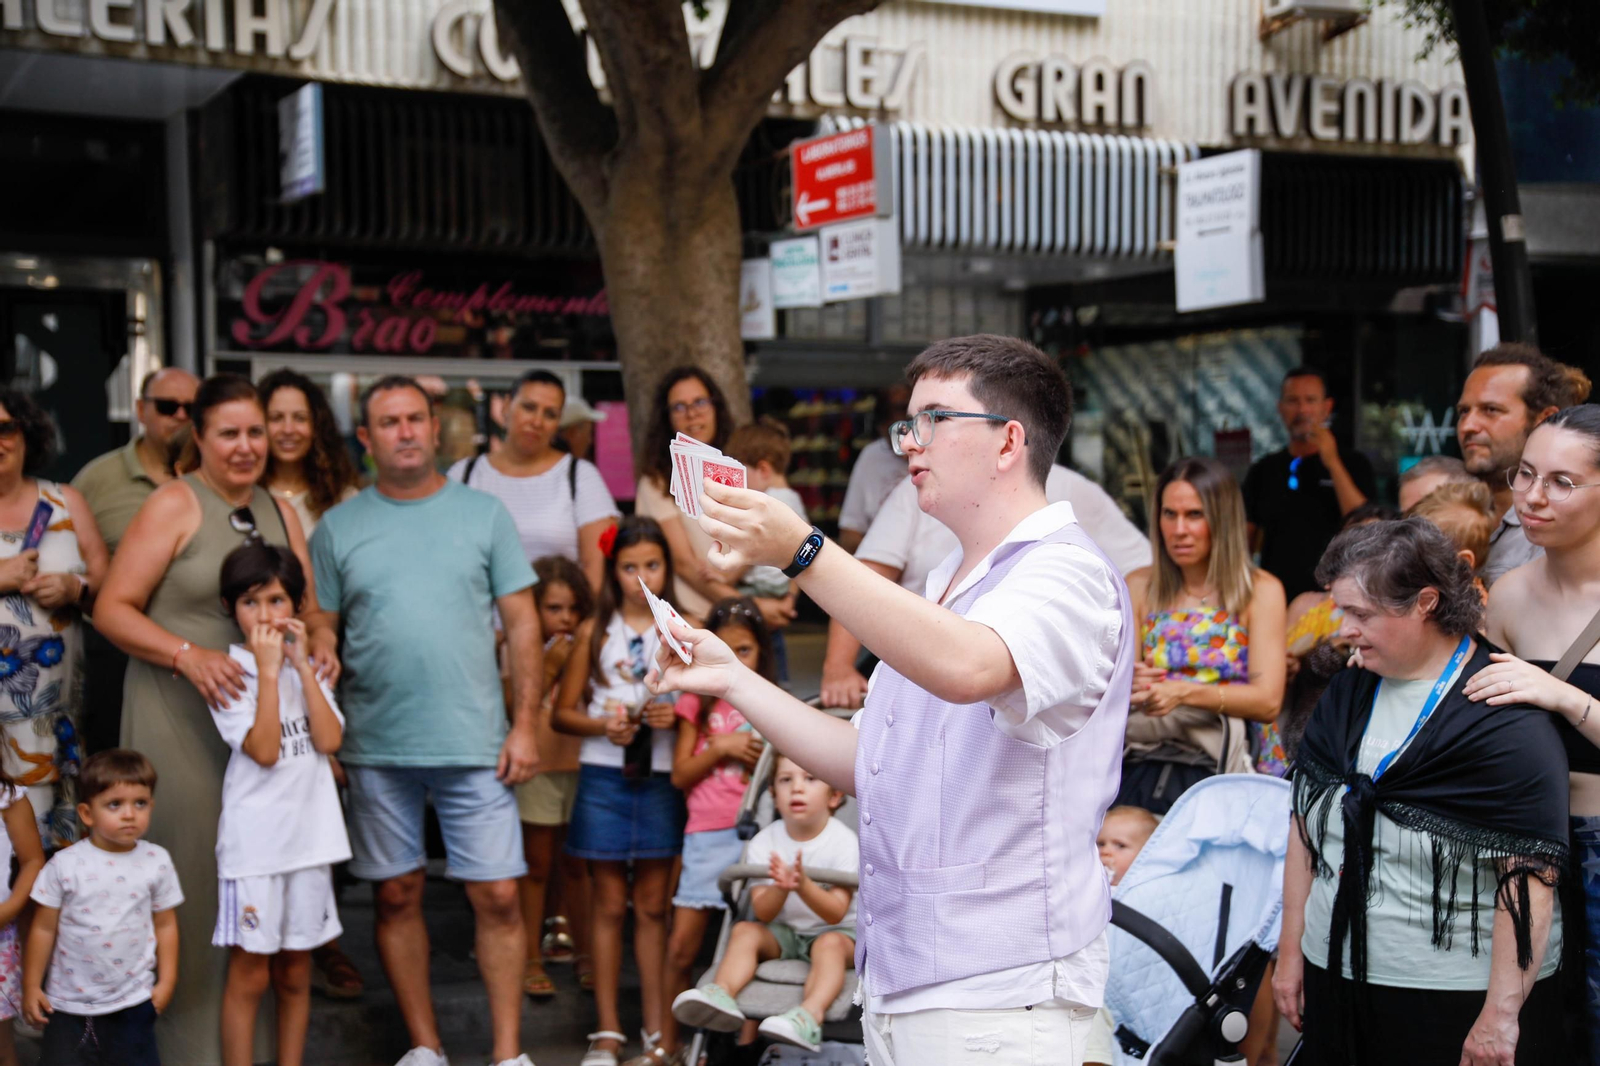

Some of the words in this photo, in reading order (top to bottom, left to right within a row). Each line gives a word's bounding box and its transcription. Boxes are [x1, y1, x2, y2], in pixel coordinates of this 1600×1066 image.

[995, 53, 1156, 127] GRAN
[1230, 71, 1472, 147] AVENIDA
[231, 260, 437, 354] Brao
[387, 270, 610, 317] Complement
